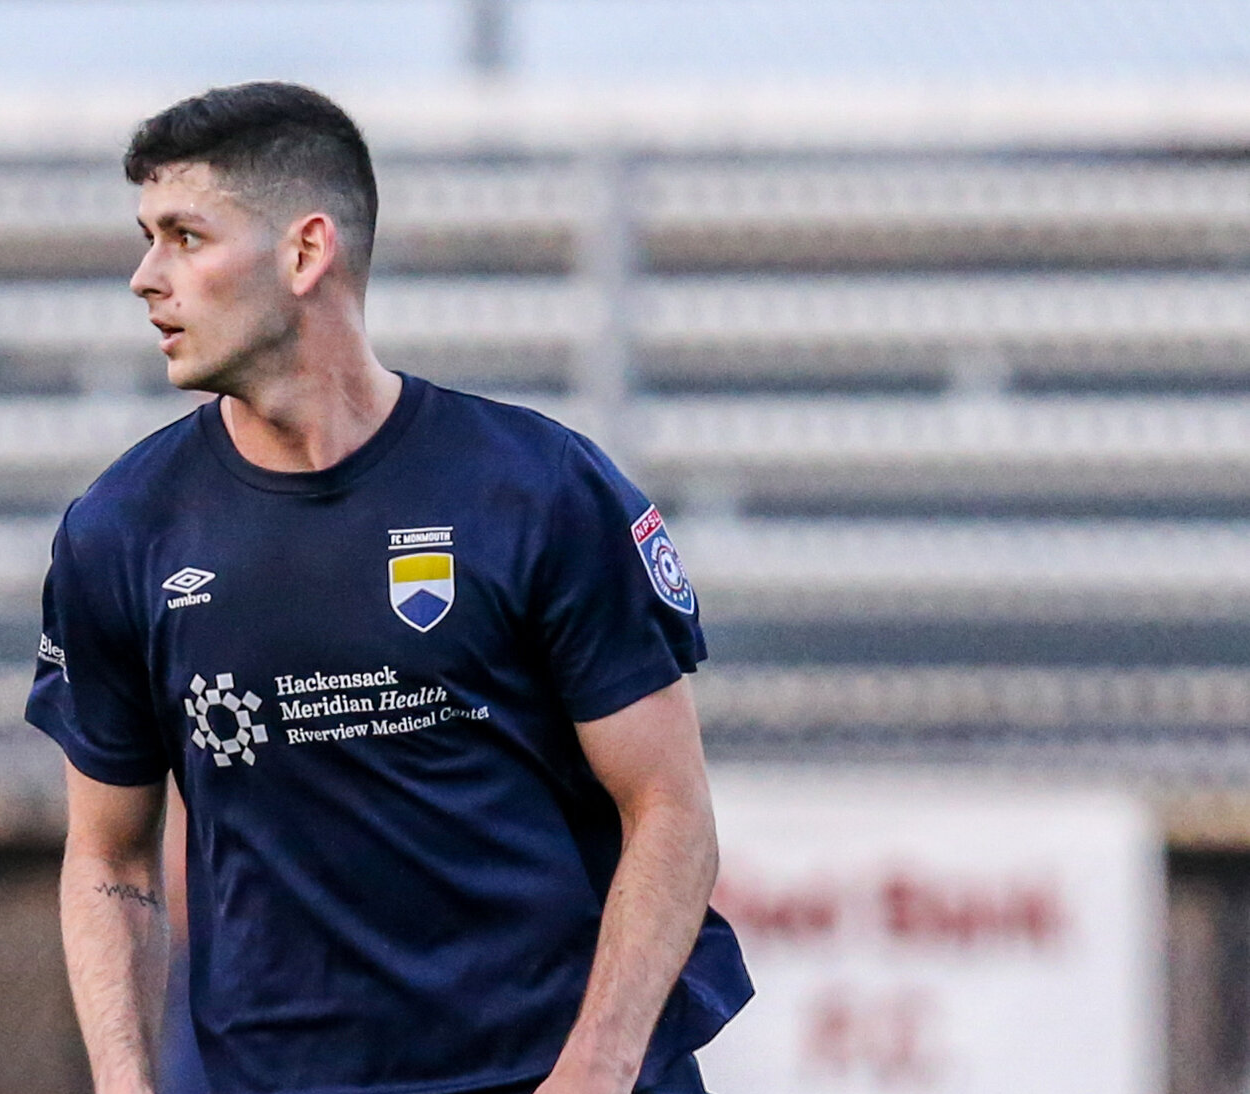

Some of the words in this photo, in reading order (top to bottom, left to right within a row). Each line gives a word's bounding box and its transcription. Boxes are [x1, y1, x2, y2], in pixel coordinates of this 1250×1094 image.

[391, 534, 402, 545] FC
[403, 531, 451, 544] MONMOUTH
[167, 592, 212, 610] umbro
[274, 665, 399, 696] Hackensack
[279, 694, 375, 720] Meridian
[378, 686, 447, 712] Health
[286, 723, 369, 745] Riverview
[370, 711, 437, 736] Medical
